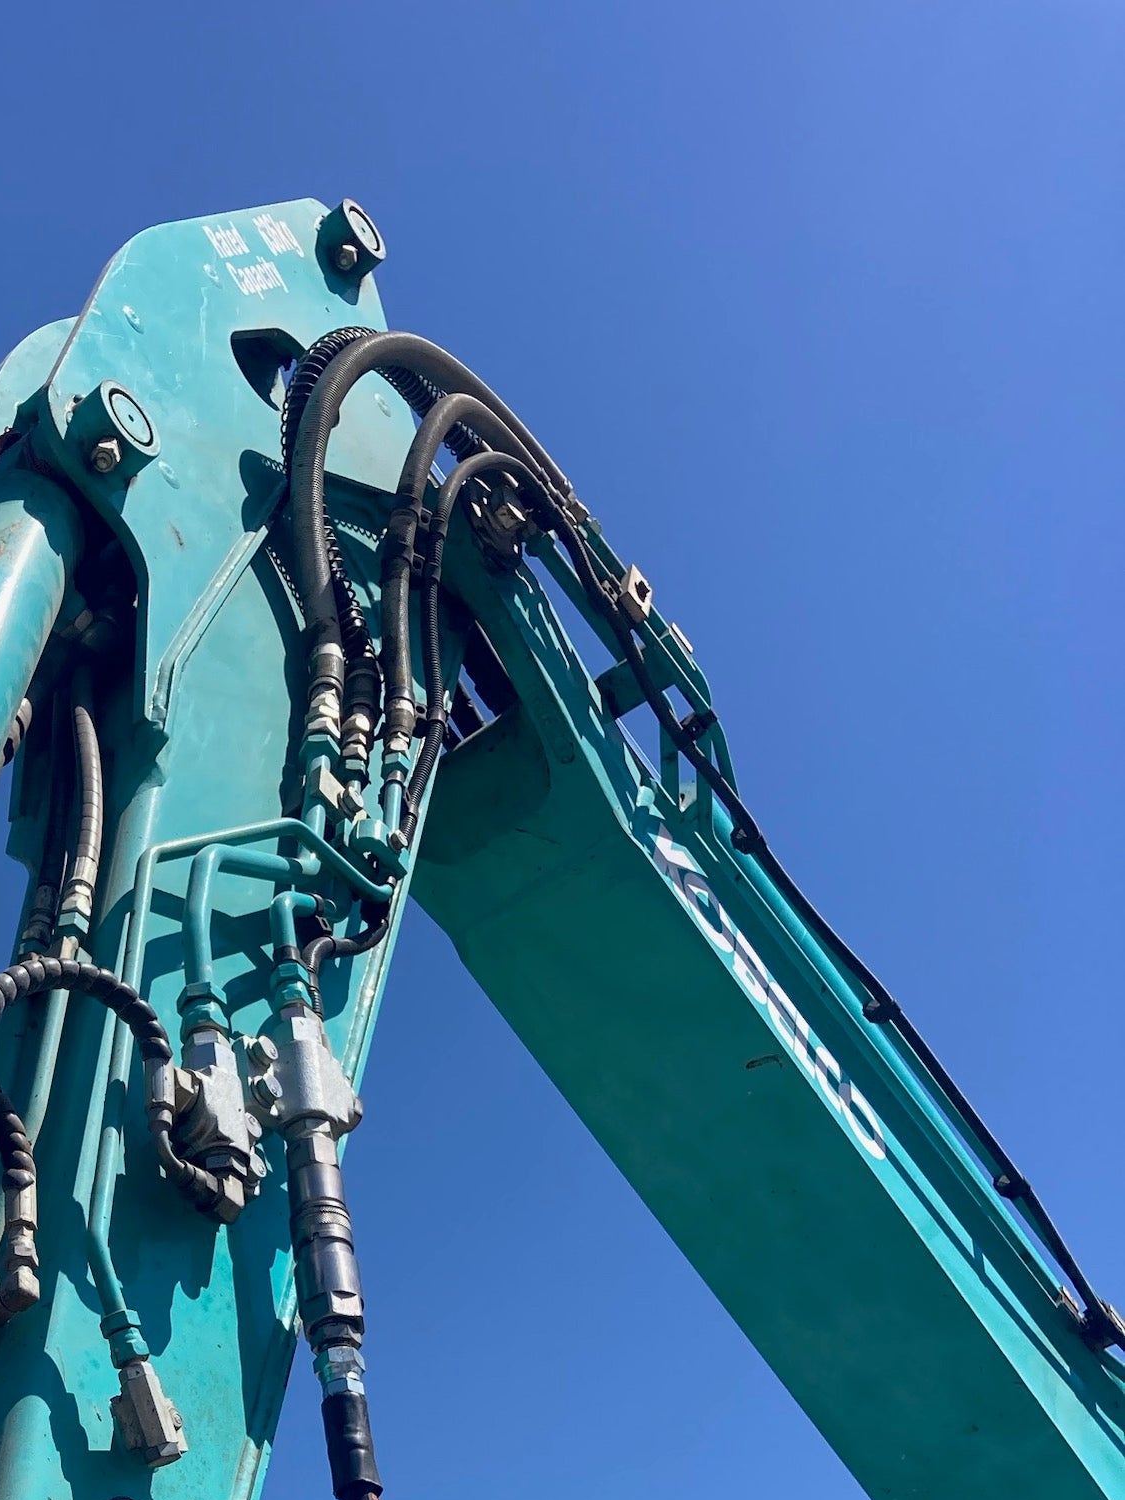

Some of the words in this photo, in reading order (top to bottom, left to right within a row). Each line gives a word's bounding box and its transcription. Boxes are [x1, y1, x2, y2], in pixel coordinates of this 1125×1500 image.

[202, 221, 250, 258] Rated
[226, 256, 288, 300] Capacity
[648, 824, 886, 1160] KOBELCO
